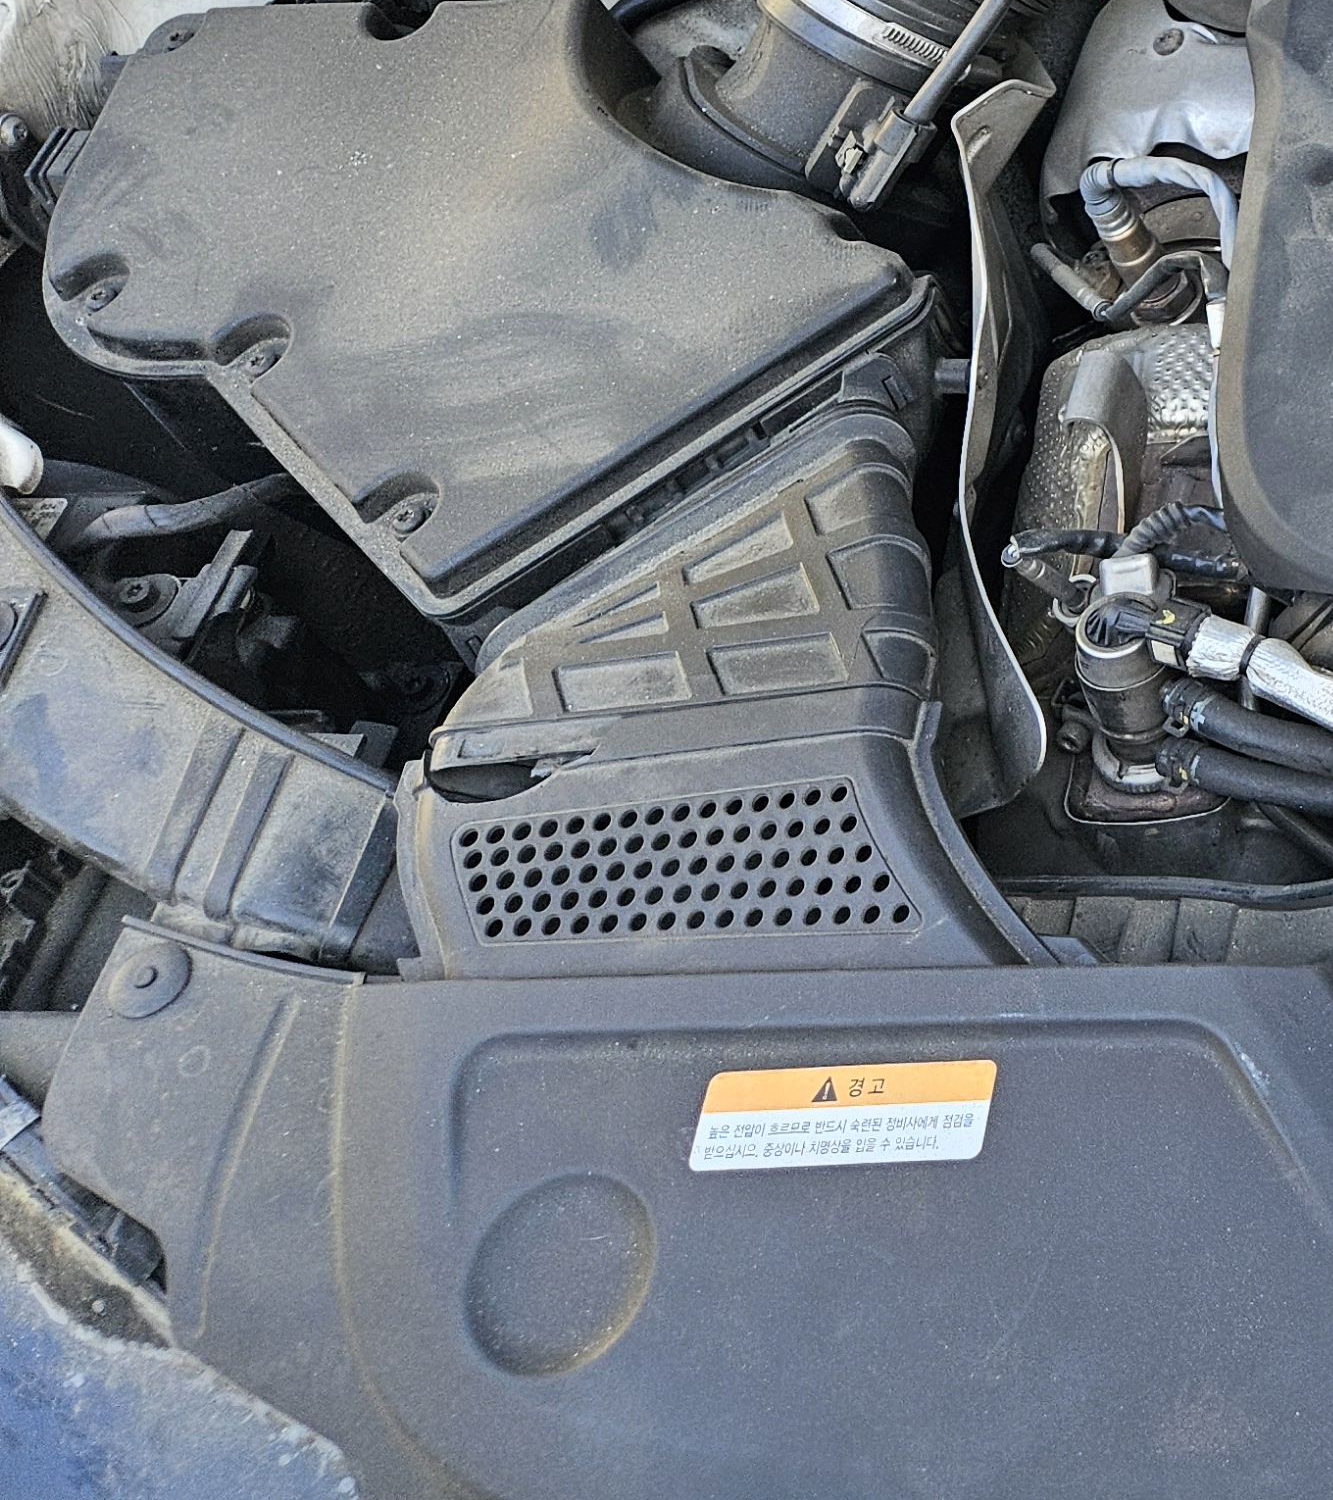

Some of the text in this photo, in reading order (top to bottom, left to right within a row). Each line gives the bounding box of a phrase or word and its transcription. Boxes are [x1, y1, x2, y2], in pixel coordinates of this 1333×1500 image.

[708, 1114, 975, 1140] 높은 전압이 흐르므로 반드시 숙련된 정비사에게 점검을
[703, 1136, 939, 1161] 받으십시오. 중상이나 치명상을 입을 수 있습니다.
